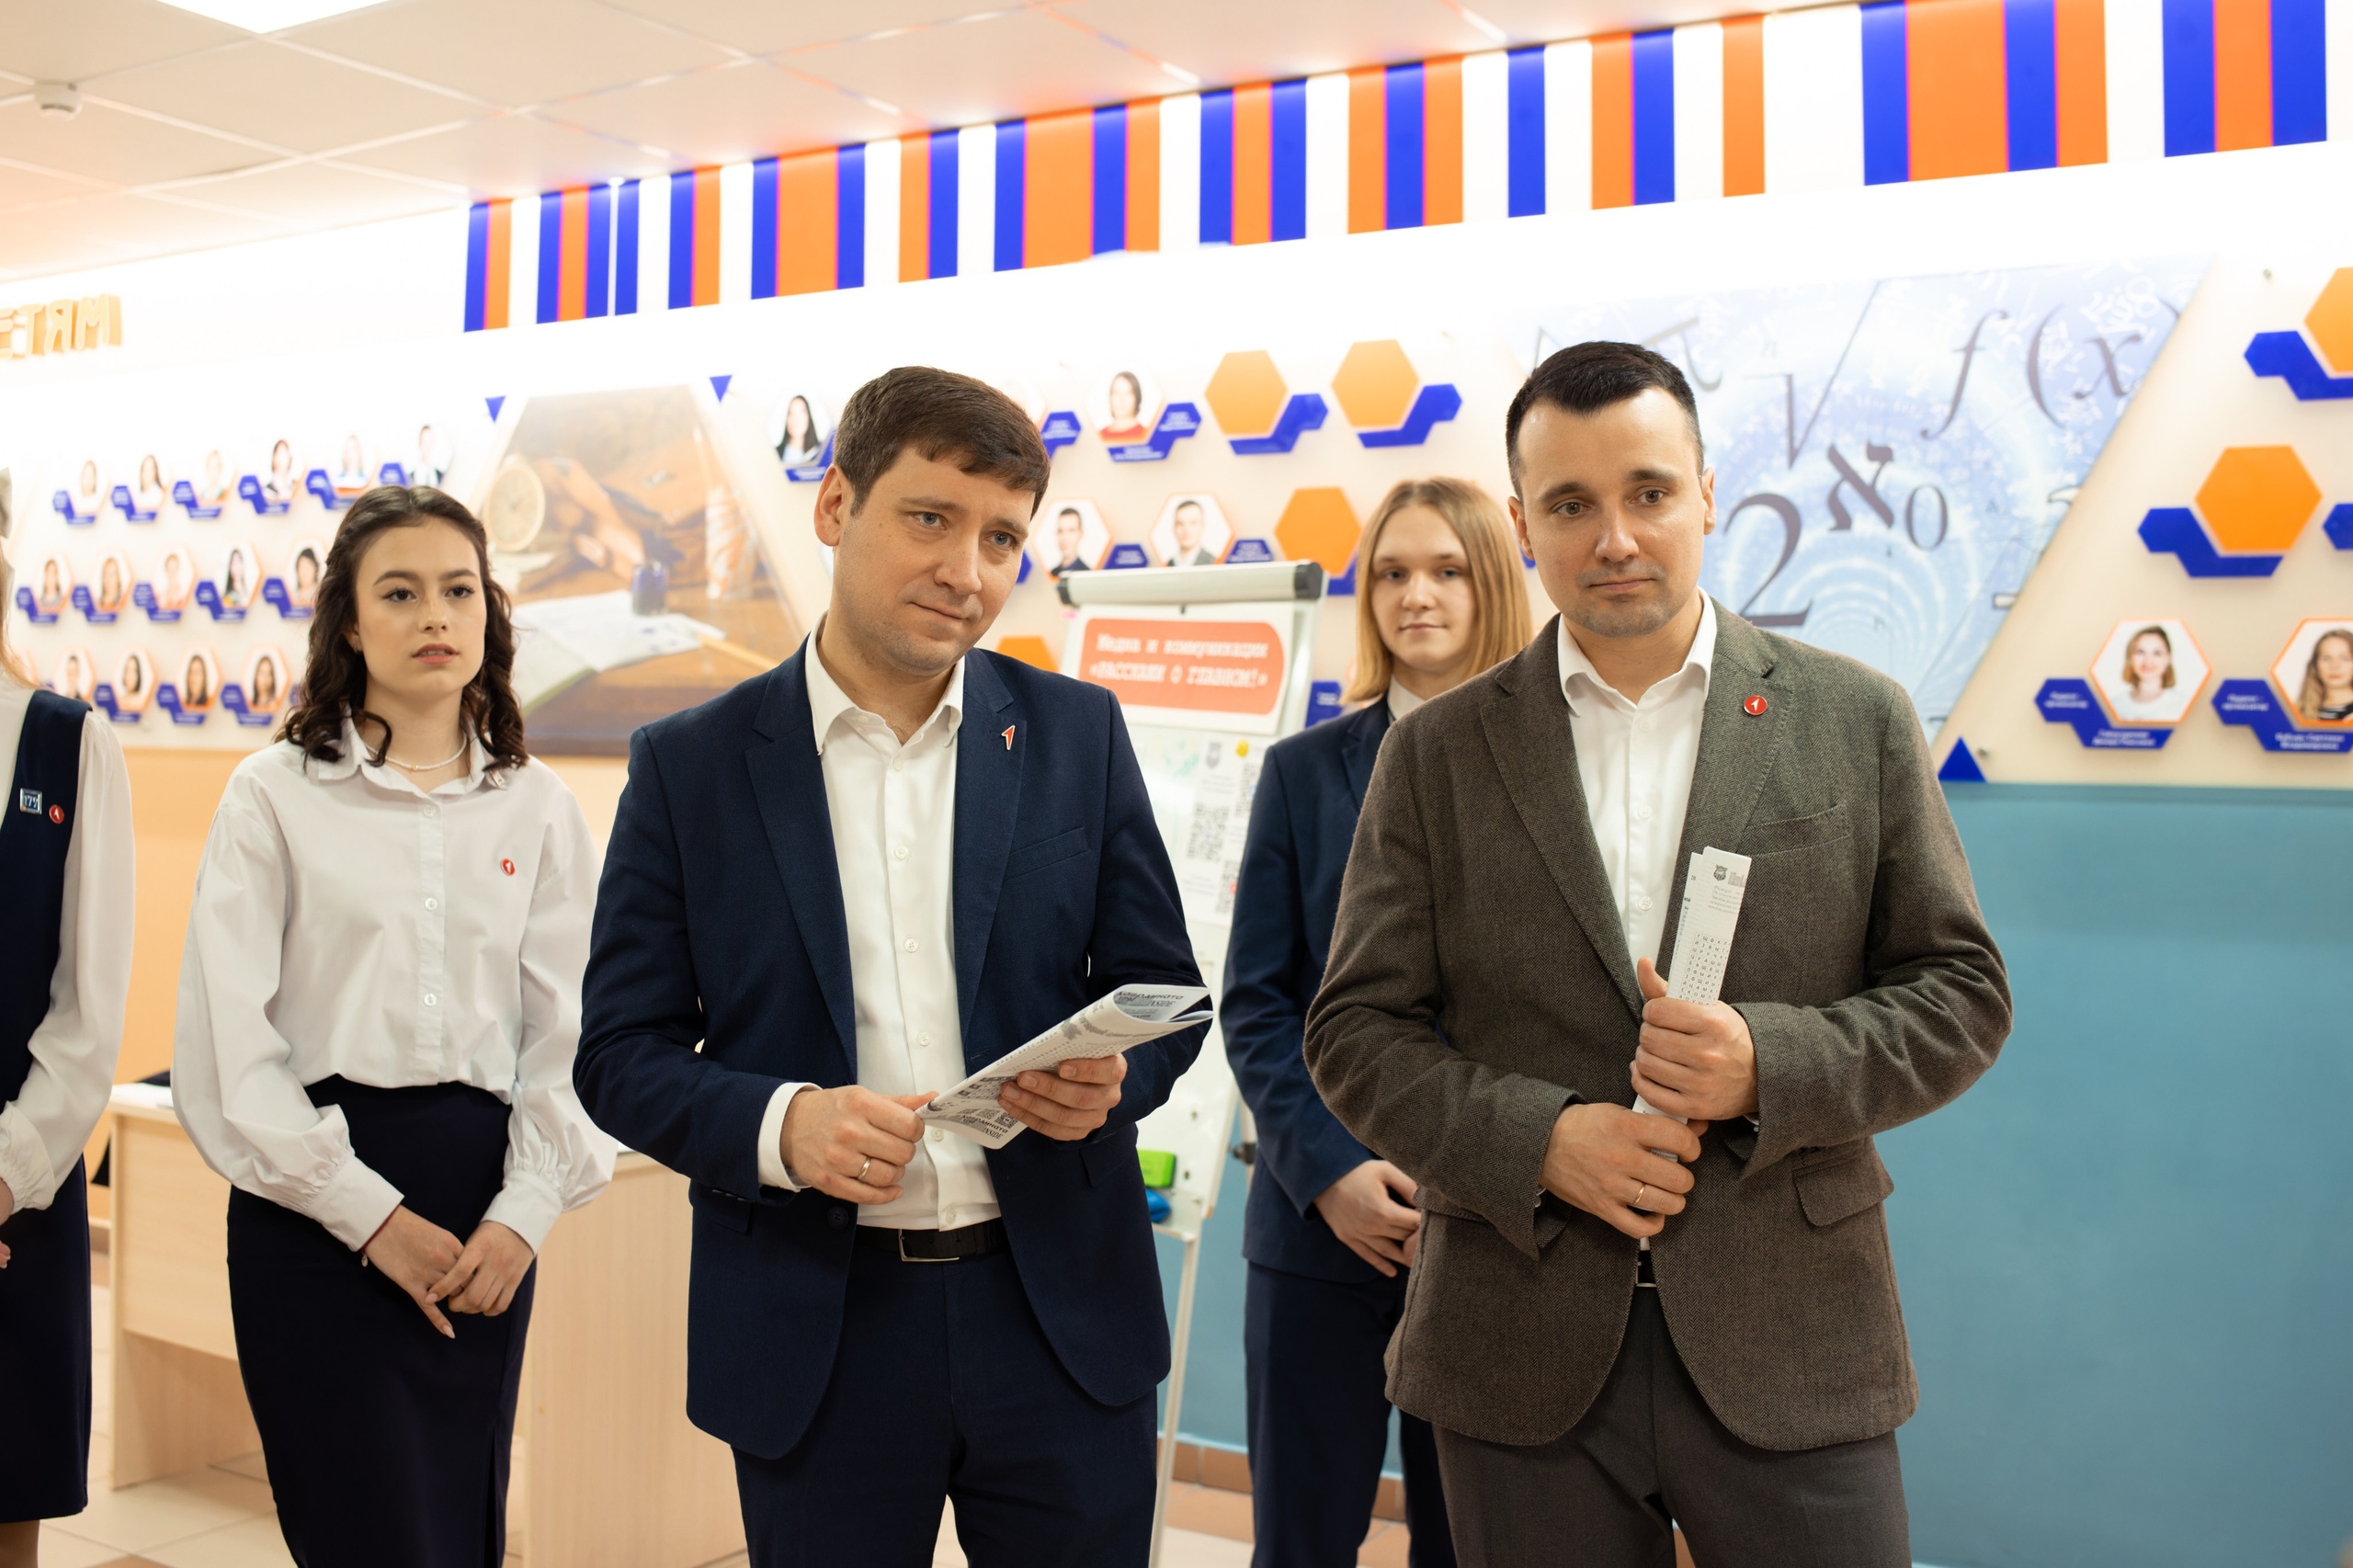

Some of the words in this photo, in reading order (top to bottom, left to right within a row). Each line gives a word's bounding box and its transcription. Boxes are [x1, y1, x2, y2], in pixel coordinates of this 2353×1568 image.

[1097, 632, 1141, 655] Медиа
[1146, 639, 1160, 653] и
[1164, 639, 1268, 659] коммуникации
[1170, 664, 1183, 685] О
[981, 1127, 1004, 1140] INSIDE
